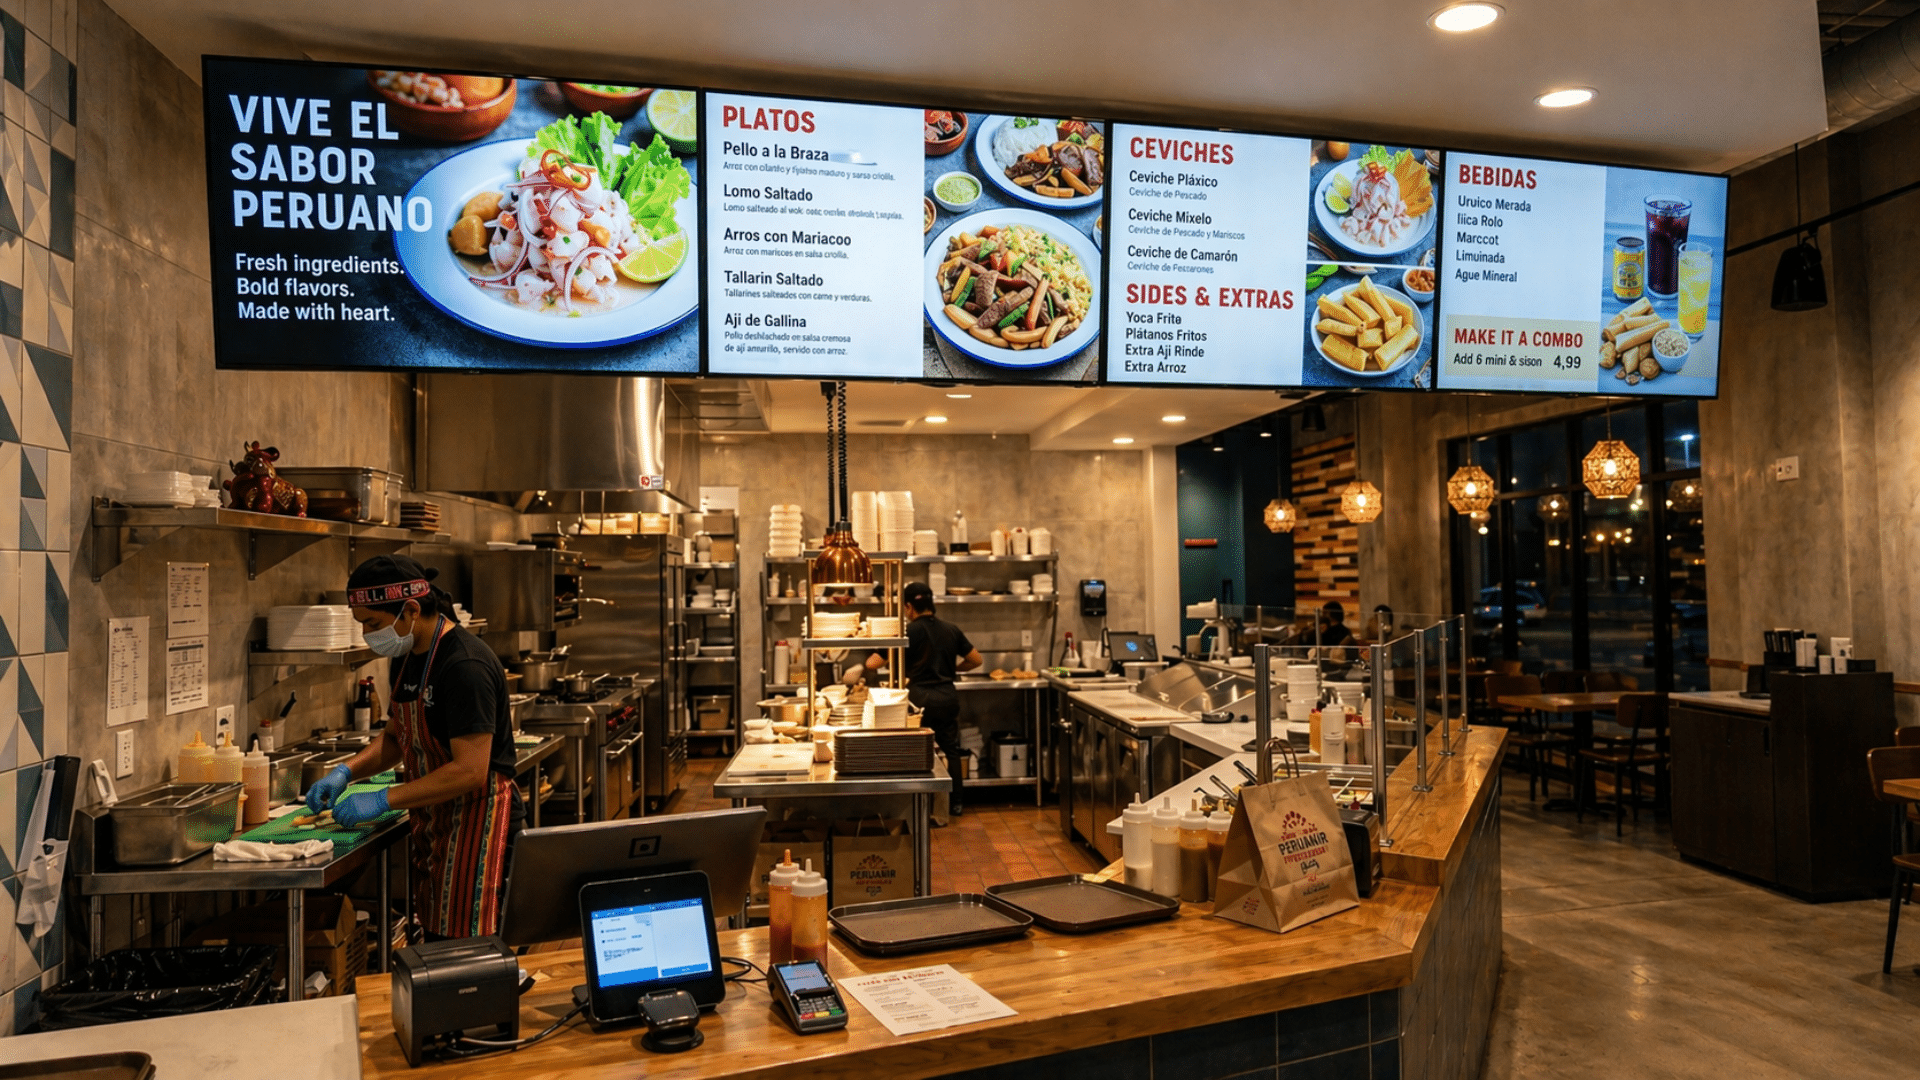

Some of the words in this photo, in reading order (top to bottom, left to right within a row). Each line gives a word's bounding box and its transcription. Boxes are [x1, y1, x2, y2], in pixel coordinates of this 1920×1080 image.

[229, 94, 331, 136] VIVE
[352, 101, 398, 140] EL
[723, 106, 815, 133] PLATOS
[724, 141, 757, 156] Pello
[762, 146, 769, 157] a
[774, 144, 786, 158] la
[791, 146, 828, 162] Braza
[1130, 136, 1234, 165] CEVICHES
[232, 142, 376, 186] SABOR
[1130, 170, 1174, 184] Ceviche
[1178, 173, 1218, 188] Pláxico
[1459, 164, 1537, 189] BEBIDAS
[724, 184, 760, 198] Lomo
[764, 186, 813, 201] Saltado
[1129, 187, 1161, 198] Ceviche
[1163, 189, 1173, 198] de
[1175, 190, 1207, 200] Pescado
[233, 190, 432, 232] PERUANO
[724, 203, 745, 212] Lomo
[1458, 195, 1492, 208] Uruico
[1495, 198, 1531, 212] Merada
[1128, 208, 1172, 222] Ceviche
[1176, 211, 1212, 225] Mixelo
[1481, 215, 1503, 227] Rolo
[724, 228, 760, 242] Arros
[764, 232, 788, 243] con
[792, 231, 851, 246] Mariacoo
[1128, 225, 1160, 235] Ceviche
[1162, 226, 1172, 235] de
[1174, 228, 1205, 237] Pescado
[1213, 230, 1245, 240] Mariscos
[1457, 231, 1499, 245] Marccot
[1128, 245, 1171, 259] Ceviche
[1175, 247, 1187, 259] de
[1191, 248, 1238, 262] Camarón
[1456, 250, 1505, 263] Limuinada
[236, 253, 288, 272] Fresh
[294, 254, 404, 276] ingredients.
[1128, 261, 1160, 271] Ceviche
[1162, 263, 1171, 272] de
[724, 270, 772, 284] Tallarin
[776, 272, 824, 286] Saltado
[1455, 268, 1480, 282] Ague
[1482, 270, 1517, 282] Mineral
[237, 278, 278, 295] Bold
[284, 278, 355, 298] flavors.
[725, 288, 760, 298] Tallarines
[1126, 283, 1187, 306] SIDES
[1195, 287, 1210, 306] &
[1219, 288, 1294, 310] EXTRAS
[238, 302, 290, 320] Made
[294, 302, 336, 320] with
[341, 303, 396, 322] heart.
[725, 313, 741, 328] Aji
[745, 314, 760, 326] de
[765, 314, 807, 327] Gallina
[1126, 311, 1153, 323] Yoca
[1157, 312, 1182, 324] Frite
[1126, 328, 1174, 340] Plátanos
[1177, 329, 1207, 341] Fritos
[1454, 328, 1496, 345] MAKE
[1502, 330, 1514, 345] IT
[1518, 331, 1528, 346] A
[1533, 332, 1583, 348] COMBO
[725, 344, 734, 352] de
[783, 345, 810, 354] servido
[1125, 344, 1154, 356] Extra
[1157, 345, 1171, 359] Aji
[1175, 346, 1204, 357] Rinde
[1125, 360, 1153, 372] Extra
[1157, 361, 1186, 373] Arroz
[1454, 353, 1473, 364] Add
[1476, 354, 1482, 365] 6
[1485, 354, 1506, 365] mini
[1509, 356, 1516, 366] &
[1519, 356, 1542, 366] sison
[1553, 355, 1581, 370] 4,99
[1278, 832, 1328, 855] PERUANIR
